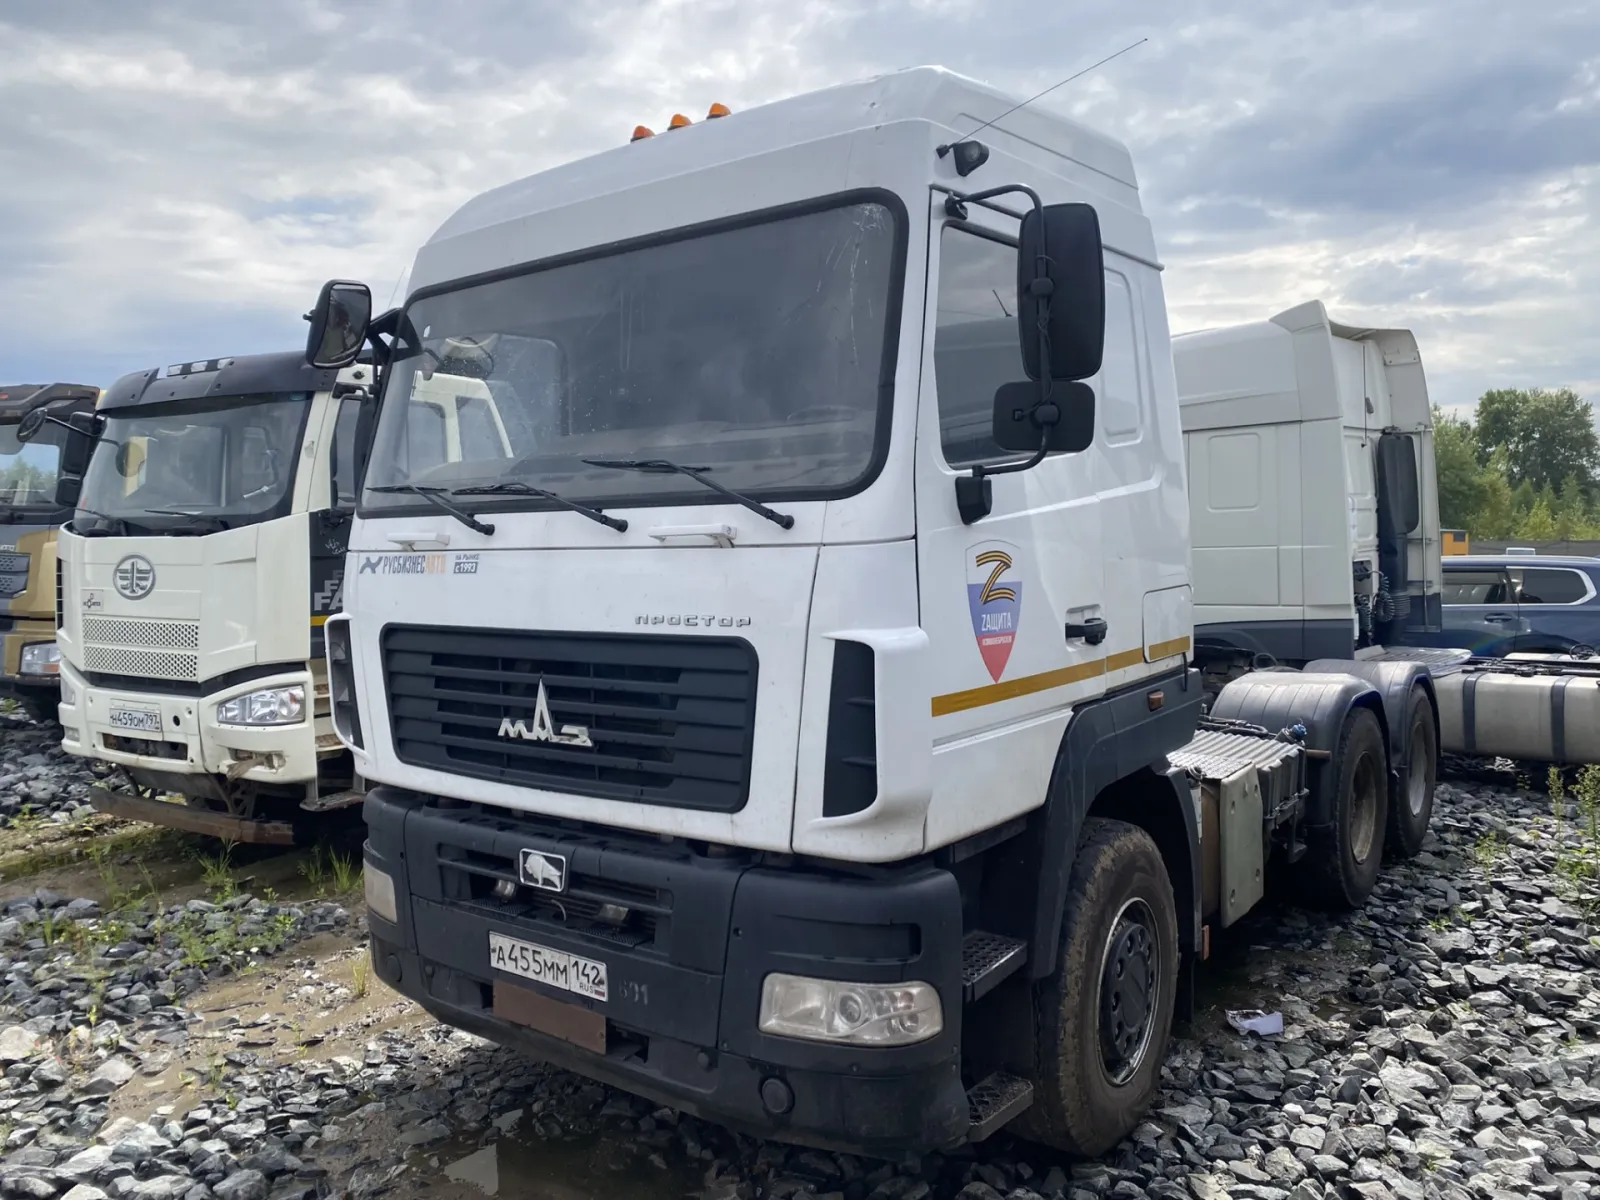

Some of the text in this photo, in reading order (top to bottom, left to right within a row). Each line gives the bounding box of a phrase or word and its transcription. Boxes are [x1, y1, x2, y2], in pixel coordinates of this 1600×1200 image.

[635, 614, 751, 627] ПРОСТОР
[498, 679, 593, 747] МАЗ
[579, 981, 594, 994] RUS
